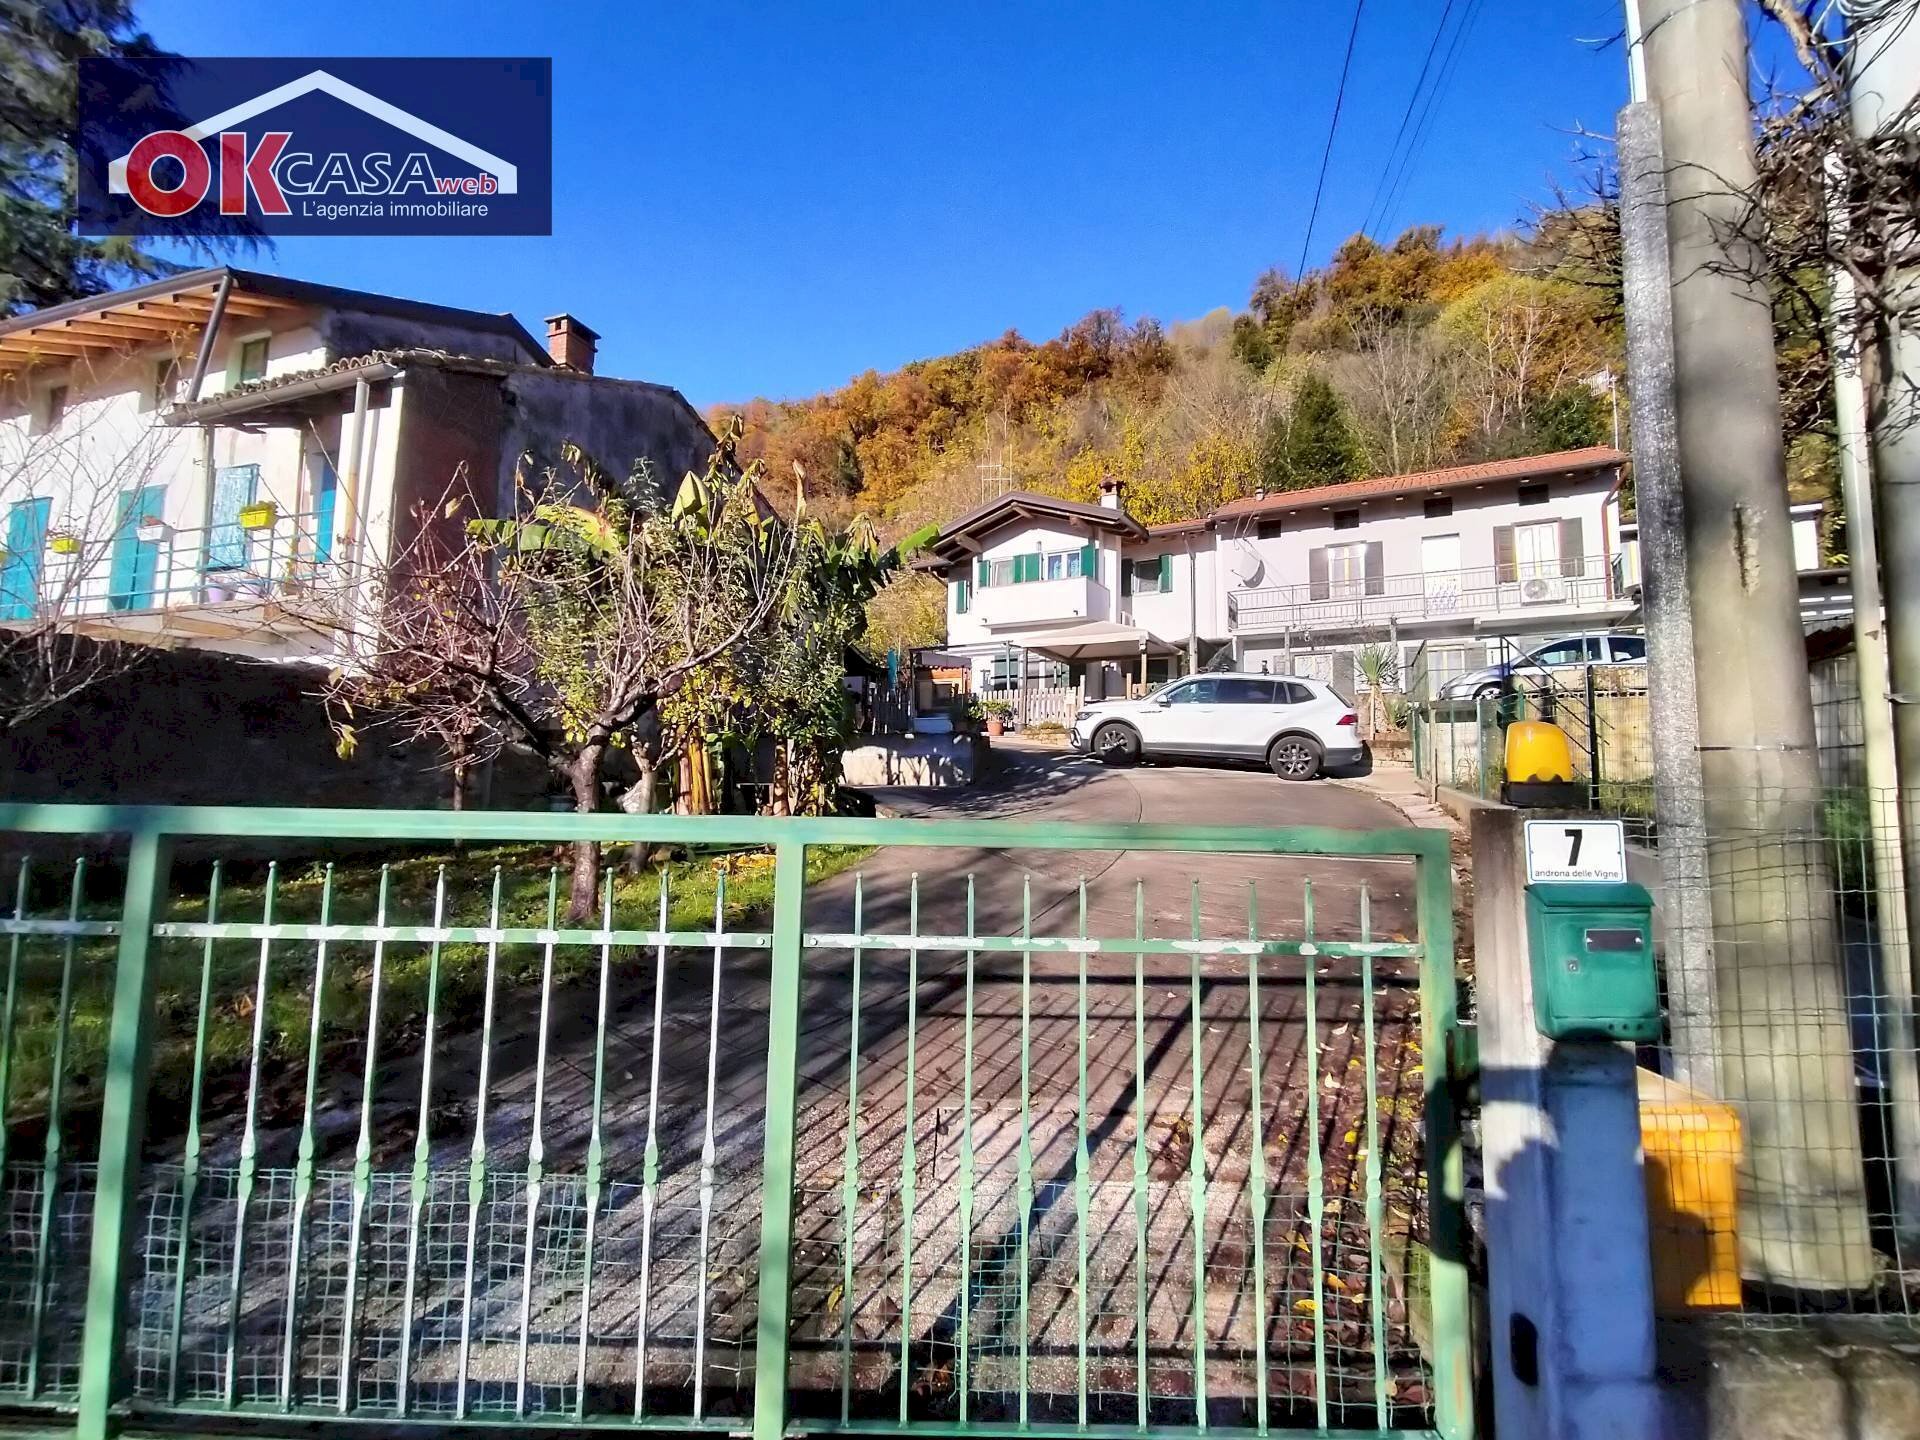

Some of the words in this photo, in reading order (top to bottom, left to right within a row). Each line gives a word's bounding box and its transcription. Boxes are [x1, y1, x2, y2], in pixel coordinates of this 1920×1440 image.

[1564, 829, 1583, 866] 7
[1535, 869, 1570, 877] androna
[1572, 869, 1592, 877] delle
[1594, 869, 1619, 879] Vigne
